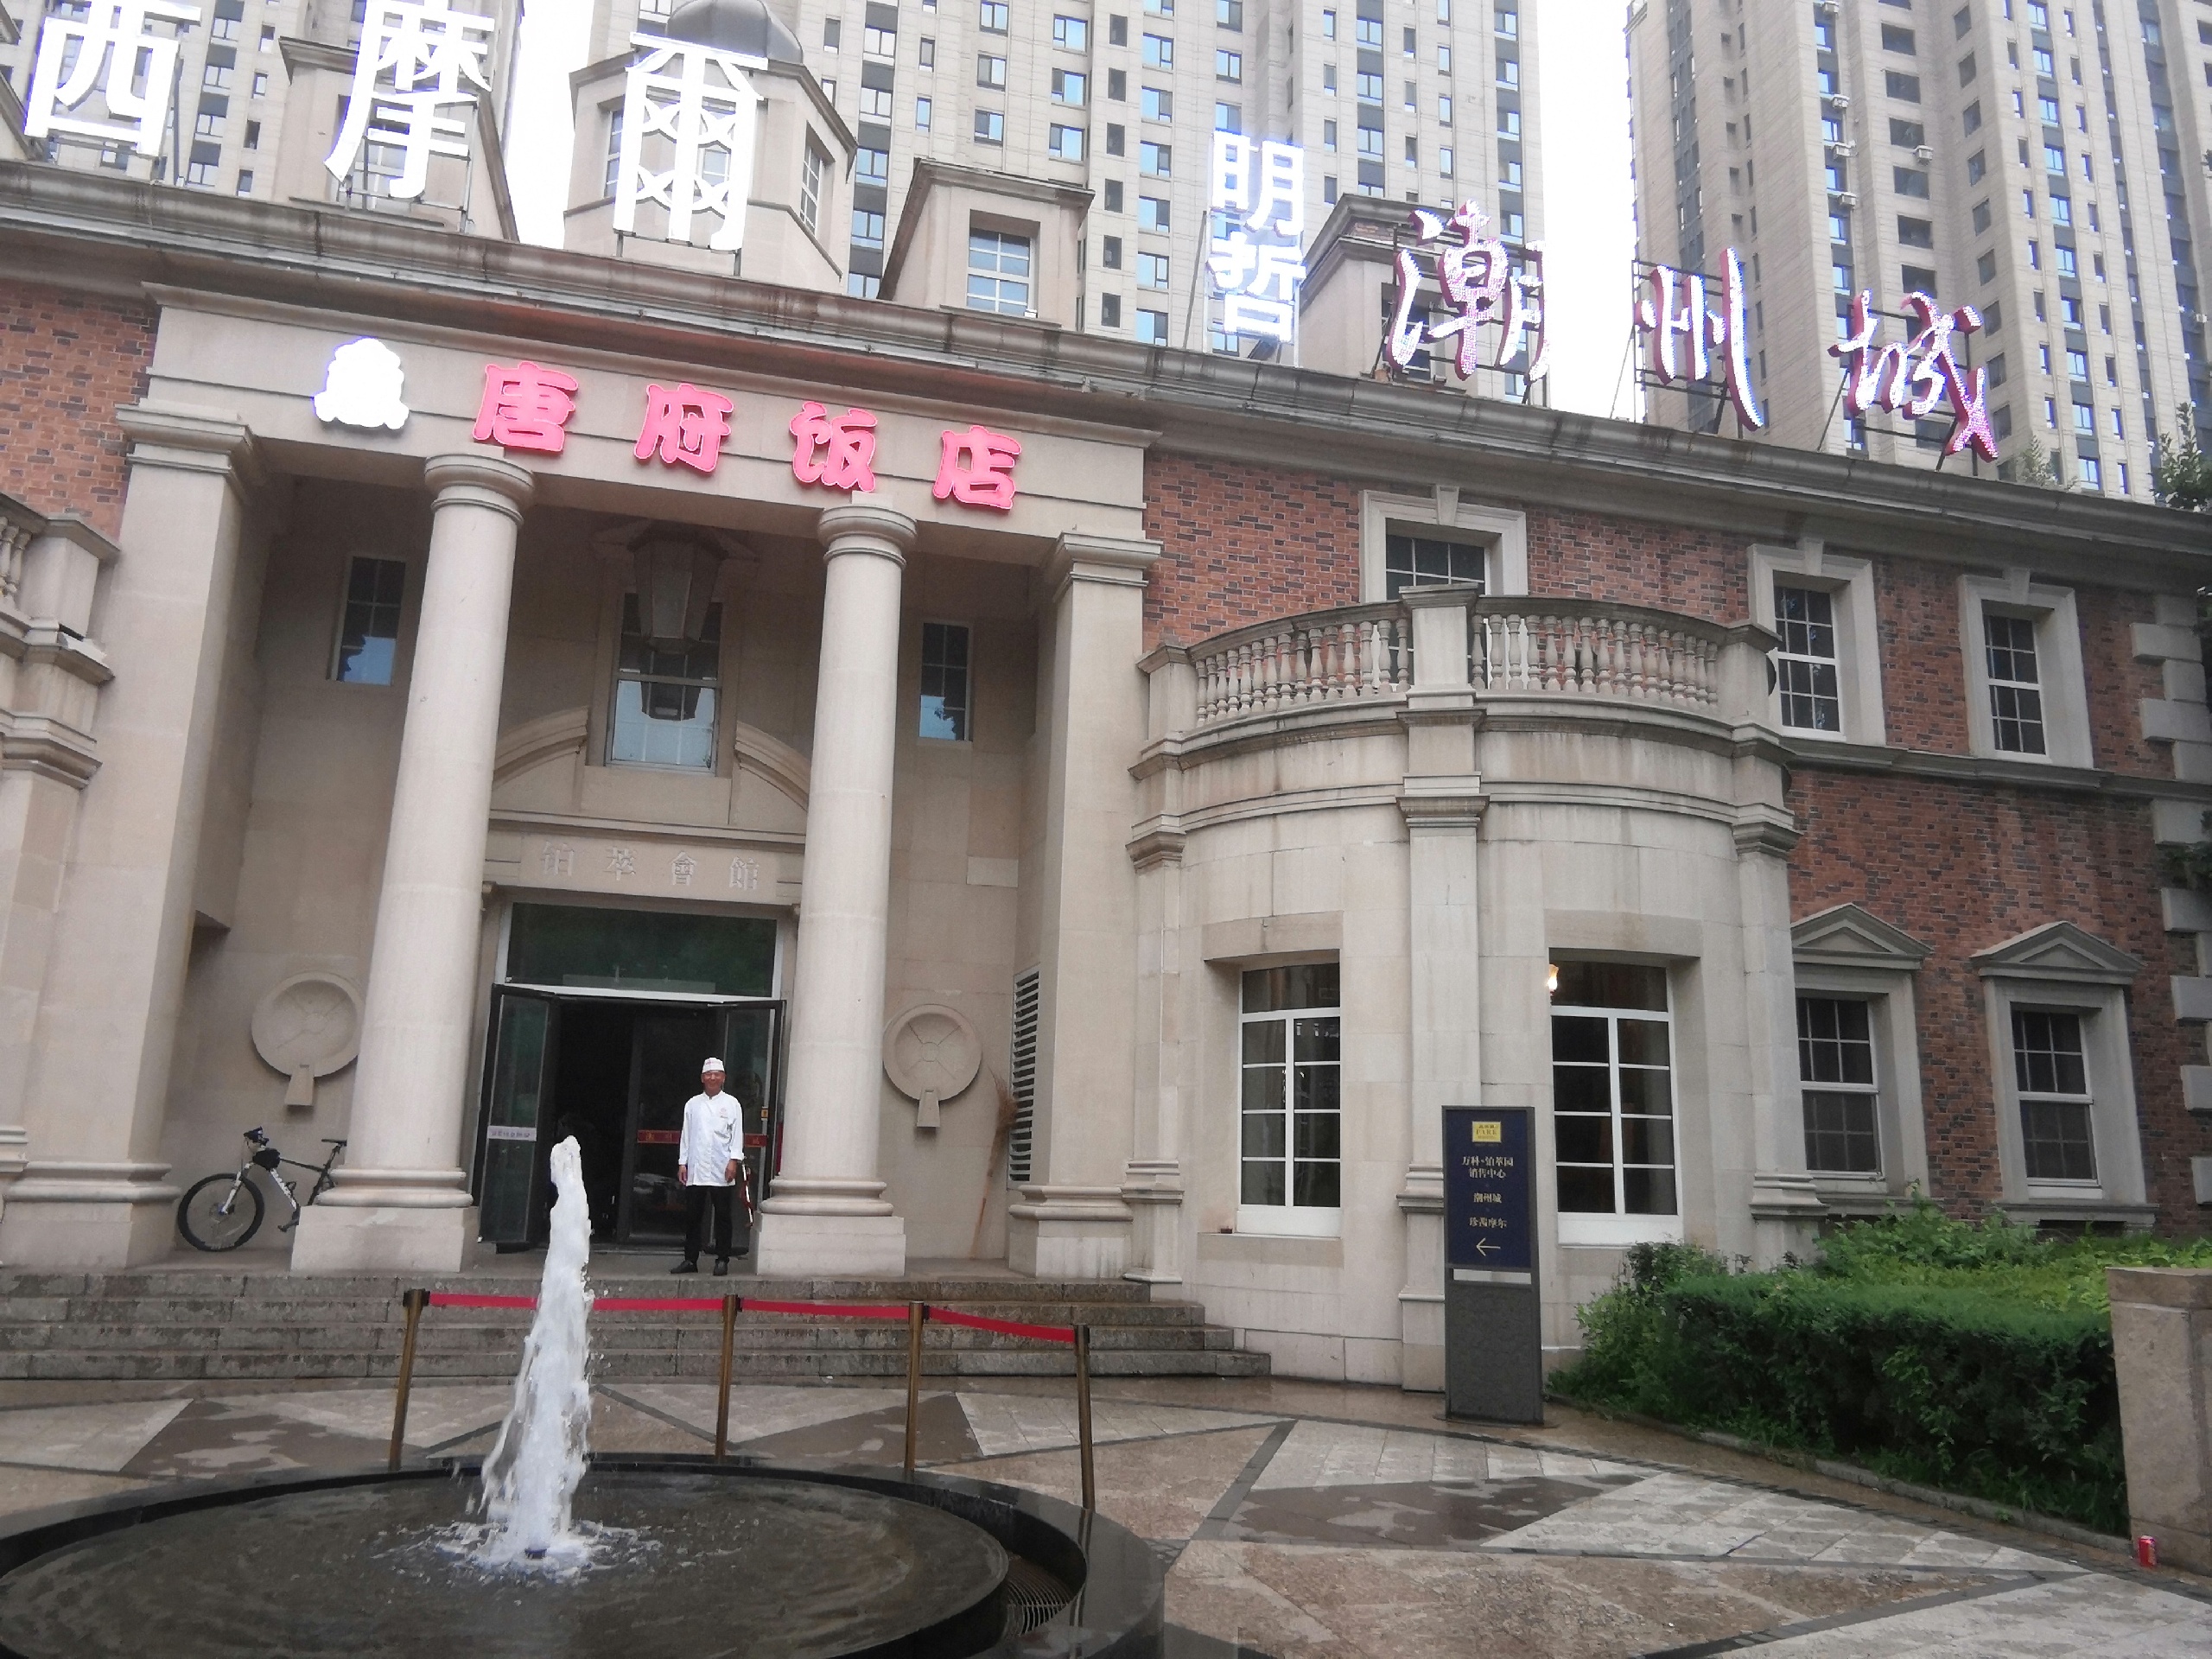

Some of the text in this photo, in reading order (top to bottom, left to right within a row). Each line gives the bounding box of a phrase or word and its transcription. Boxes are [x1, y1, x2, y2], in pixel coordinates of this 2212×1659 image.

[24, 0, 769, 251] 西摩爾
[1208, 129, 1307, 343] 明哲
[472, 359, 1022, 512] 唐府饭店
[1386, 199, 1999, 464] 潮州城
